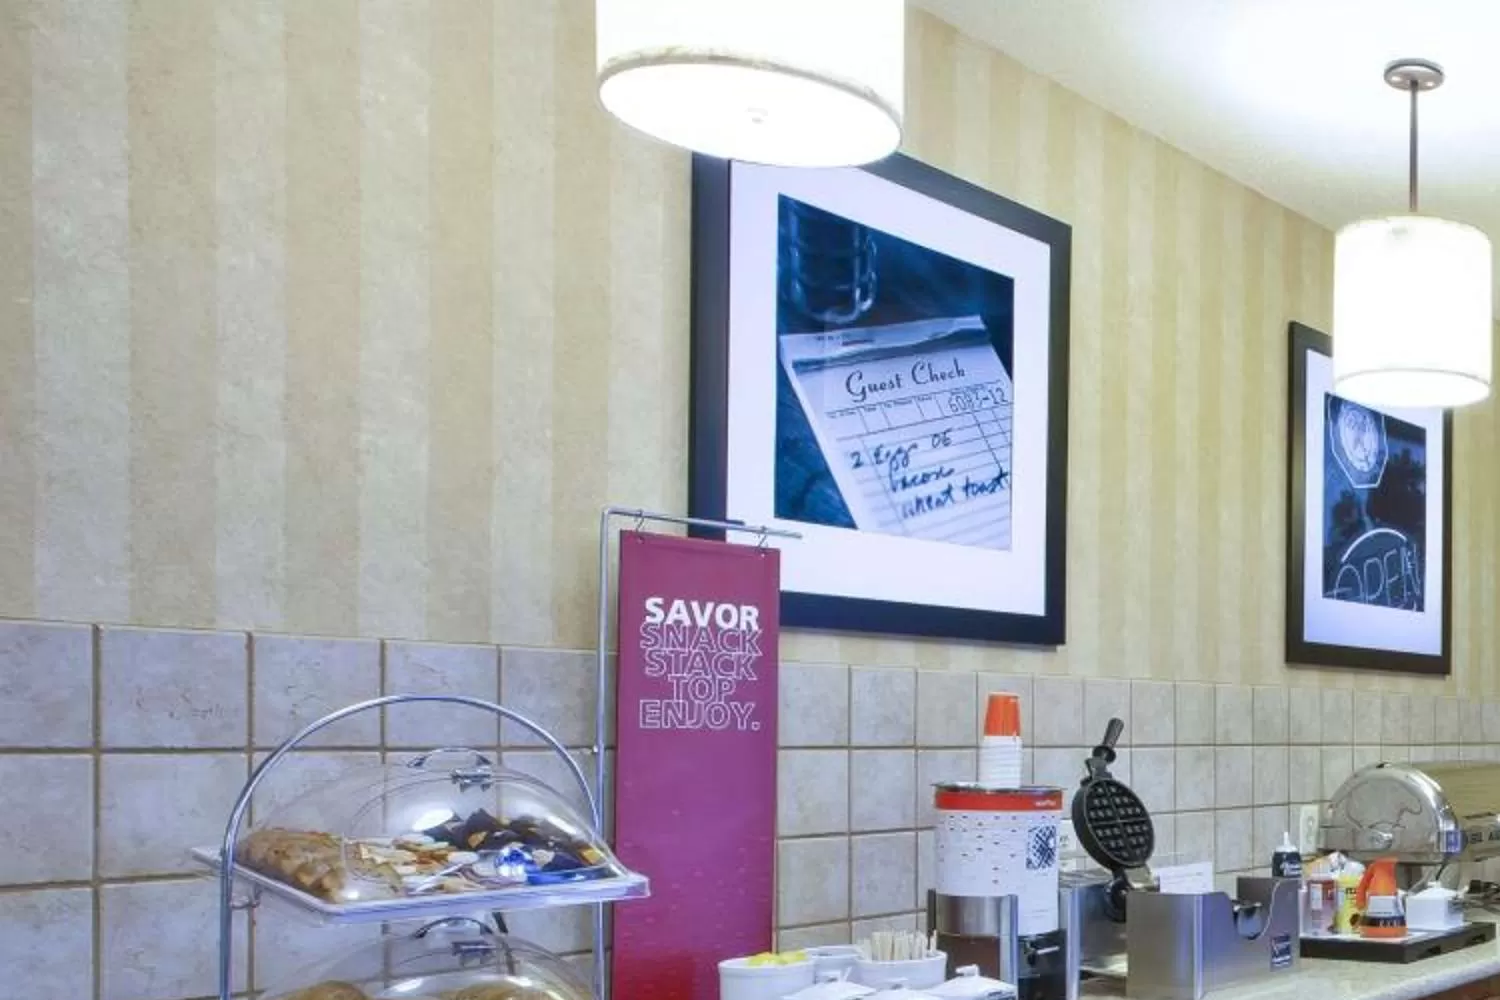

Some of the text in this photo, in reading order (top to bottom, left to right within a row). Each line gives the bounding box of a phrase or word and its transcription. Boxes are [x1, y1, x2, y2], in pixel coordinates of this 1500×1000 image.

[846, 356, 966, 402] Guest Check
[850, 451, 864, 469] 2
[1334, 543, 1421, 606] OPEN
[644, 597, 760, 631] SAVOR
[639, 621, 763, 656] SNACK
[645, 647, 758, 681] STACK
[667, 674, 736, 703] TOP
[639, 699, 761, 731] ENJOY.
